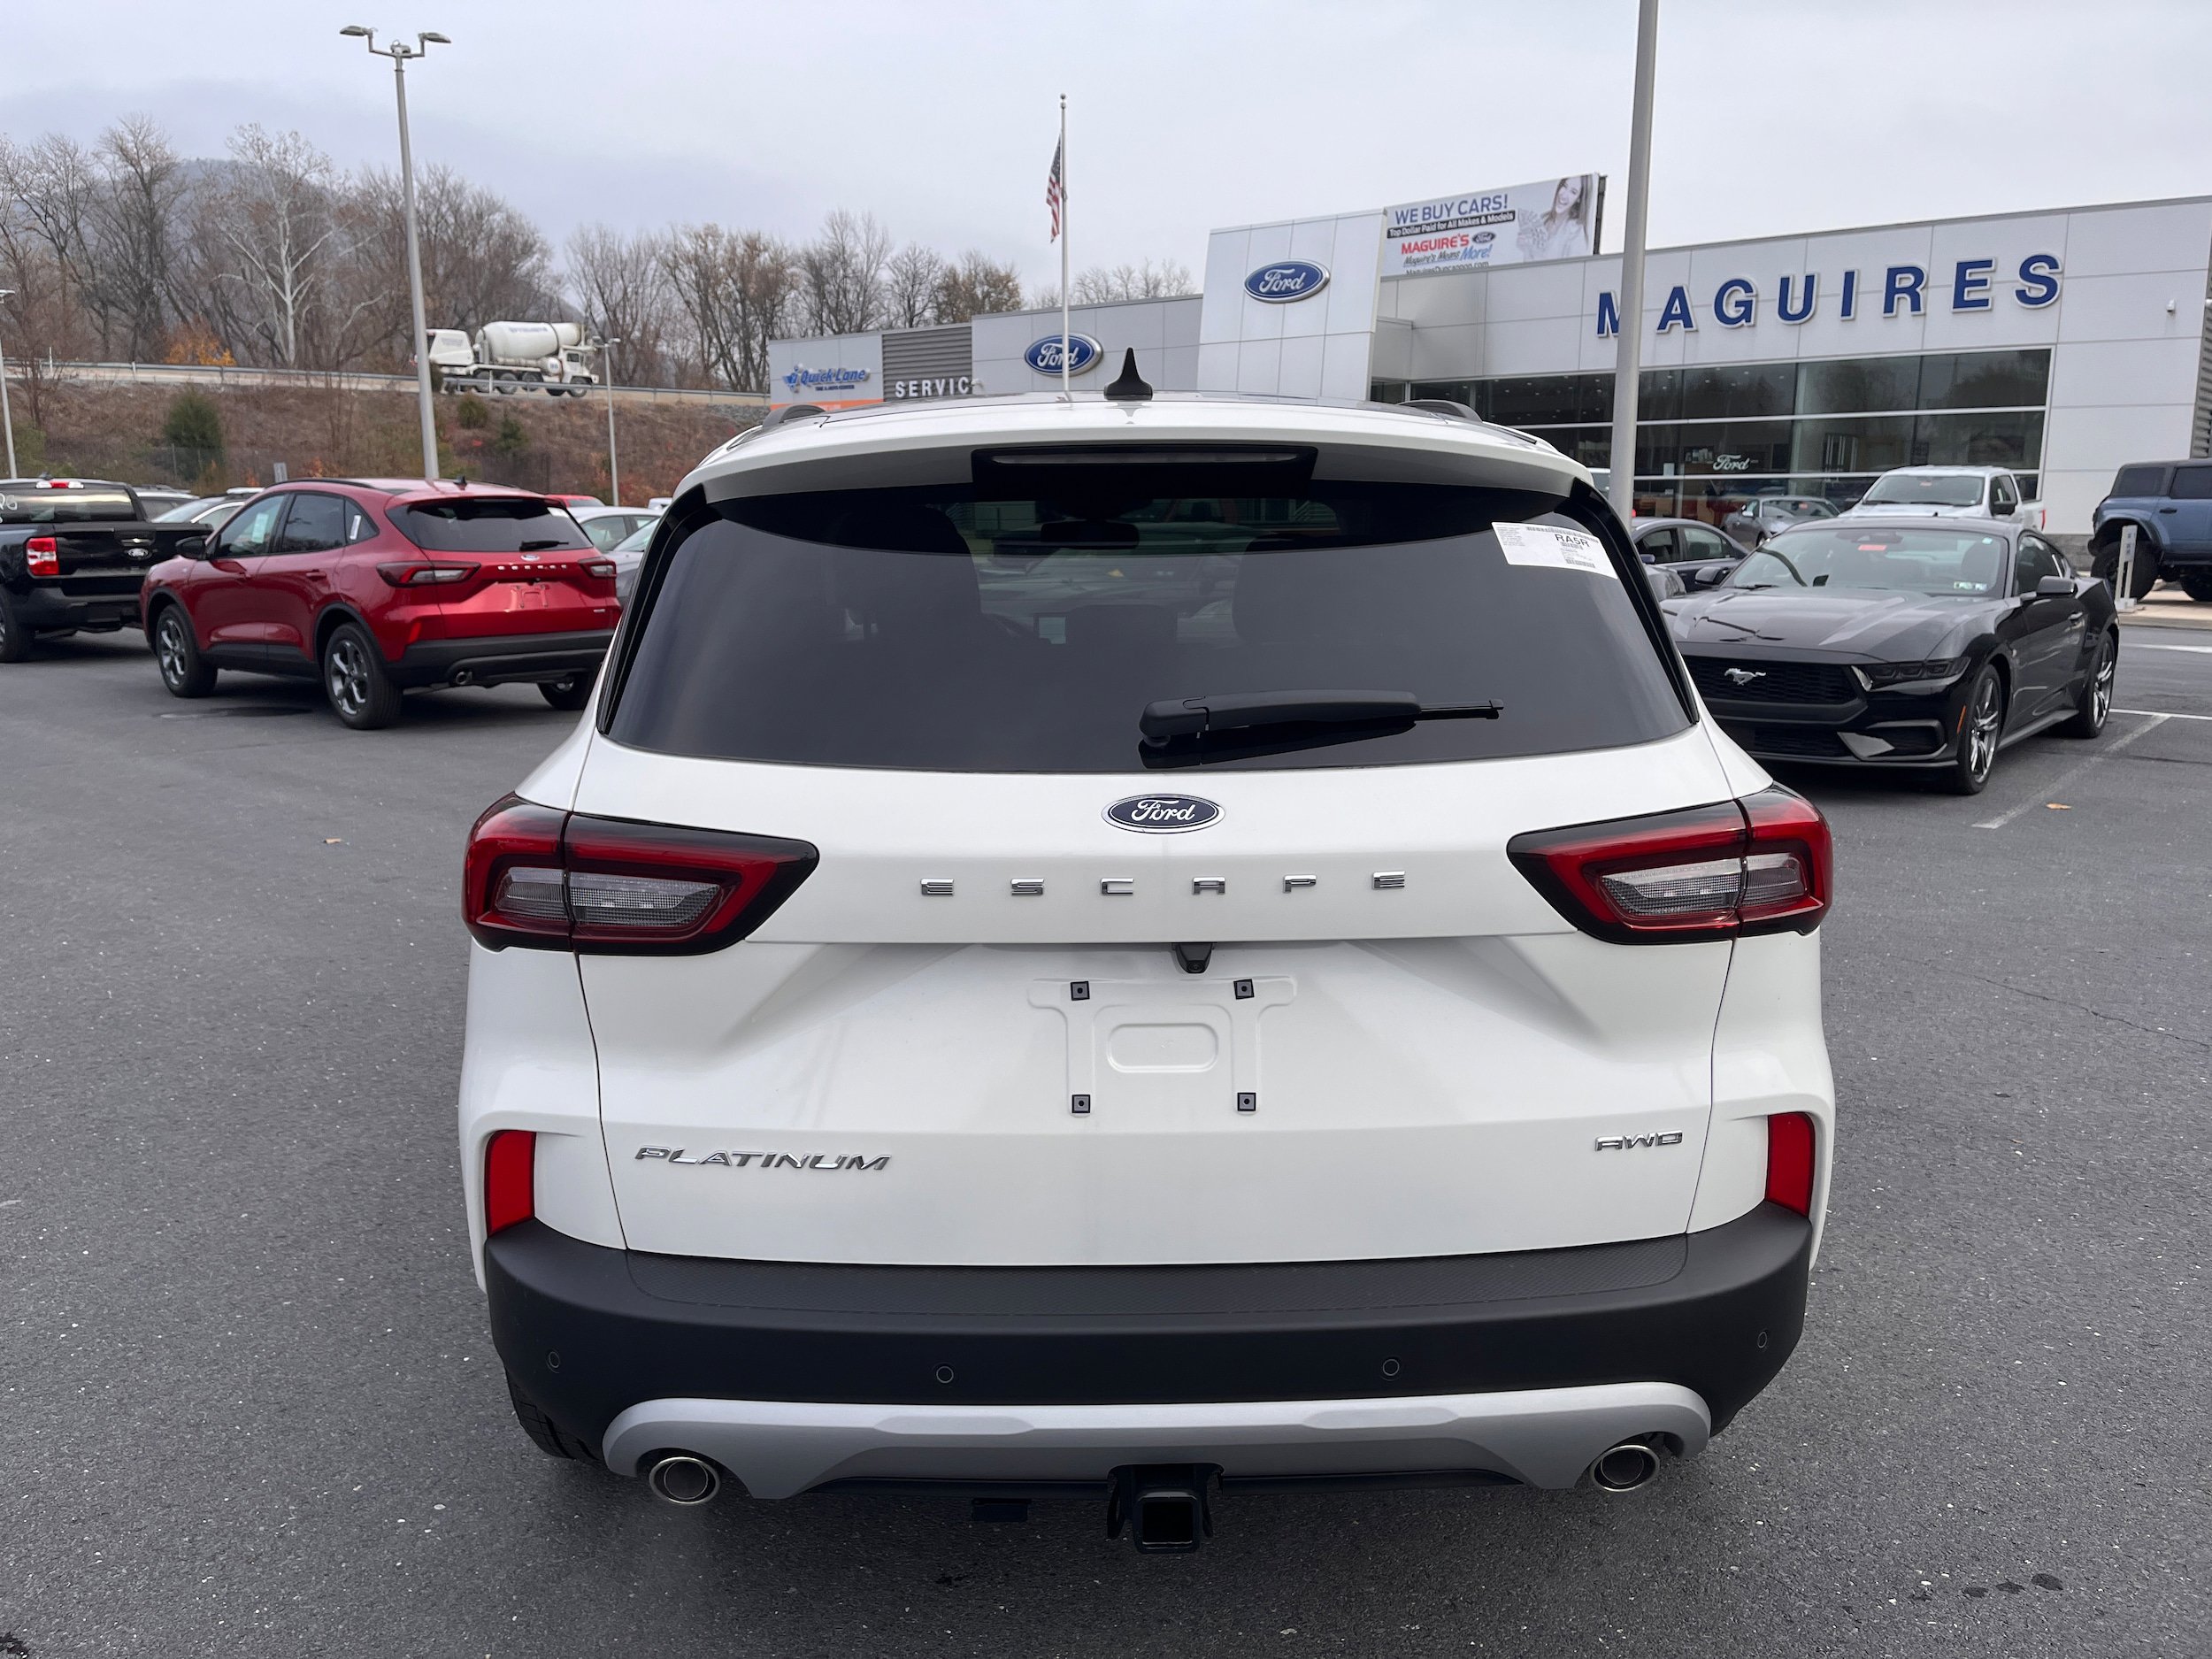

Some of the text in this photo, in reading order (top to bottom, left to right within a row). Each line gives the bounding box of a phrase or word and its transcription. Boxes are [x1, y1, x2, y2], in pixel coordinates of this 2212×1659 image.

[1395, 194, 1508, 225] WE BUY CARS!
[1402, 234, 1470, 254] MAGUIRE'S
[1460, 244, 1494, 261] More!
[1259, 268, 1306, 293] Ford
[800, 368, 866, 386] Quick Lane
[1712, 454, 1751, 471] Ford
[1555, 534, 1590, 547] RA5R
[1131, 799, 1196, 821] Ford
[920, 871, 1406, 896] ESCAPE
[1594, 1130, 1683, 1152] AWD
[634, 1144, 893, 1171] PLATINUM
